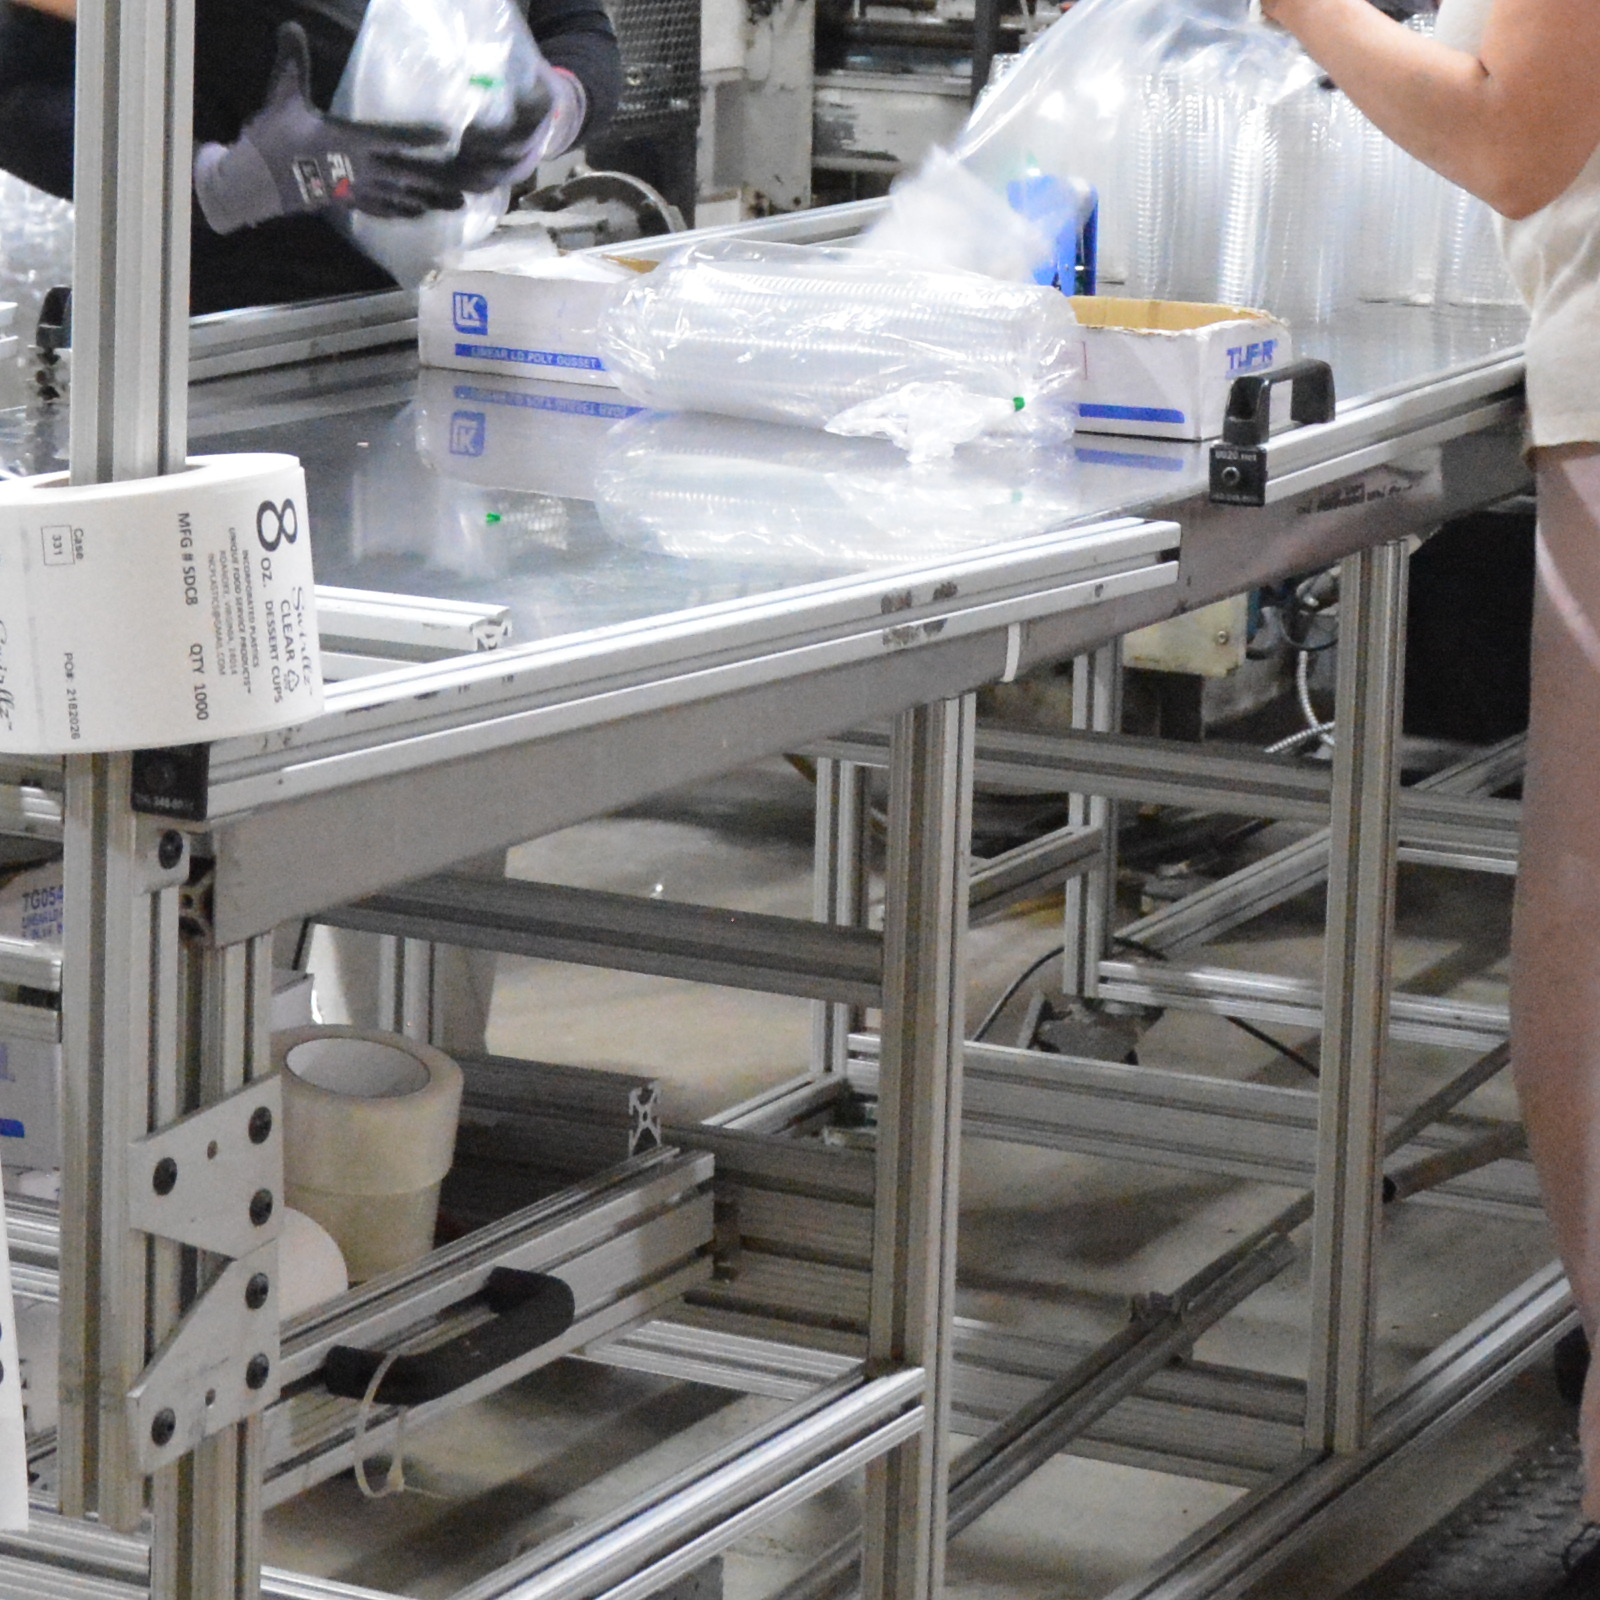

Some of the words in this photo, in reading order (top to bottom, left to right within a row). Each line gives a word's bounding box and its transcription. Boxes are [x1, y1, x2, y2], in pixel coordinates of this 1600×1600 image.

[471, 346, 509, 360] LINEAR
[527, 352, 554, 365] POLY
[556, 355, 598, 369] GUSSET
[178, 512, 193, 548] MFG
[256, 498, 298, 552] 8
[52, 534, 62, 556] 331
[73, 528, 84, 560] Case
[182, 553, 193, 561] #
[183, 566, 198, 606] SDC8
[232, 568, 242, 595] FOOD
[235, 597, 246, 633] SERVICE
[242, 550, 255, 623] INCORPORATED
[249, 625, 260, 668] PLASTICS
[265, 601, 279, 661] DESSERT
[281, 600, 296, 662] CLEAR
[189, 643, 205, 675] QTY
[194, 683, 209, 721] 1000
[271, 666, 283, 703] CUPS
[66, 689, 80, 740] 2182026
